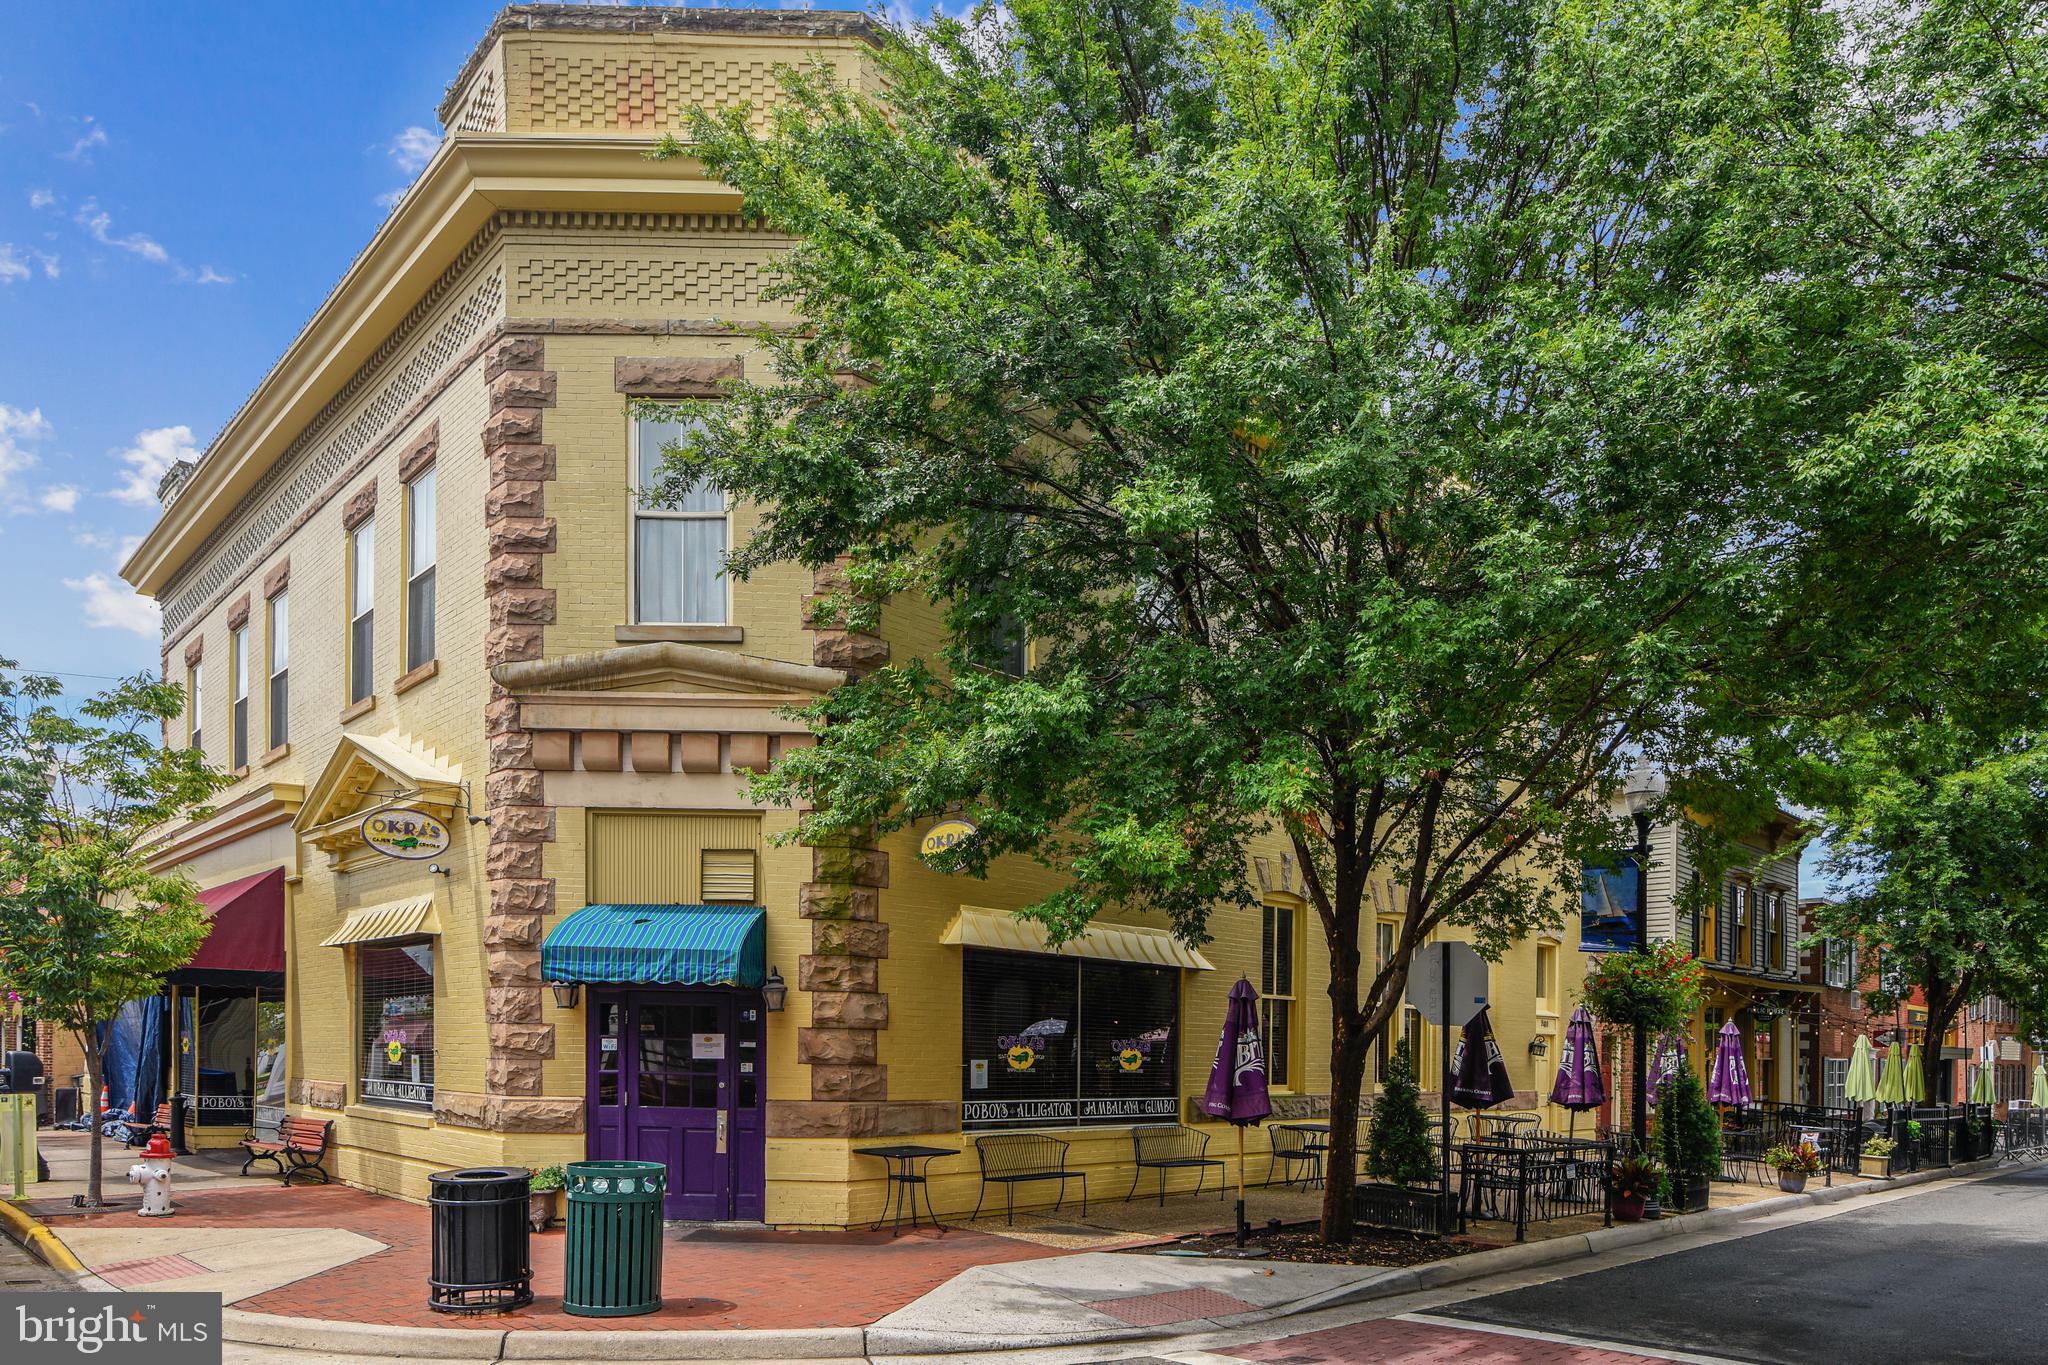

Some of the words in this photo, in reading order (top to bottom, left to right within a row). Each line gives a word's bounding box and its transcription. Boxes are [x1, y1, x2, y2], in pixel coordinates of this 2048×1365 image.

[372, 819, 441, 838] OKRA'S
[398, 1083, 427, 1101] ALLIGATOR
[964, 1102, 1009, 1120] PO'BOYS
[1016, 1101, 1073, 1118] ALLIGATOR
[1083, 1100, 1140, 1115] JAMBALAYA
[1144, 1099, 1176, 1113] GUMBO
